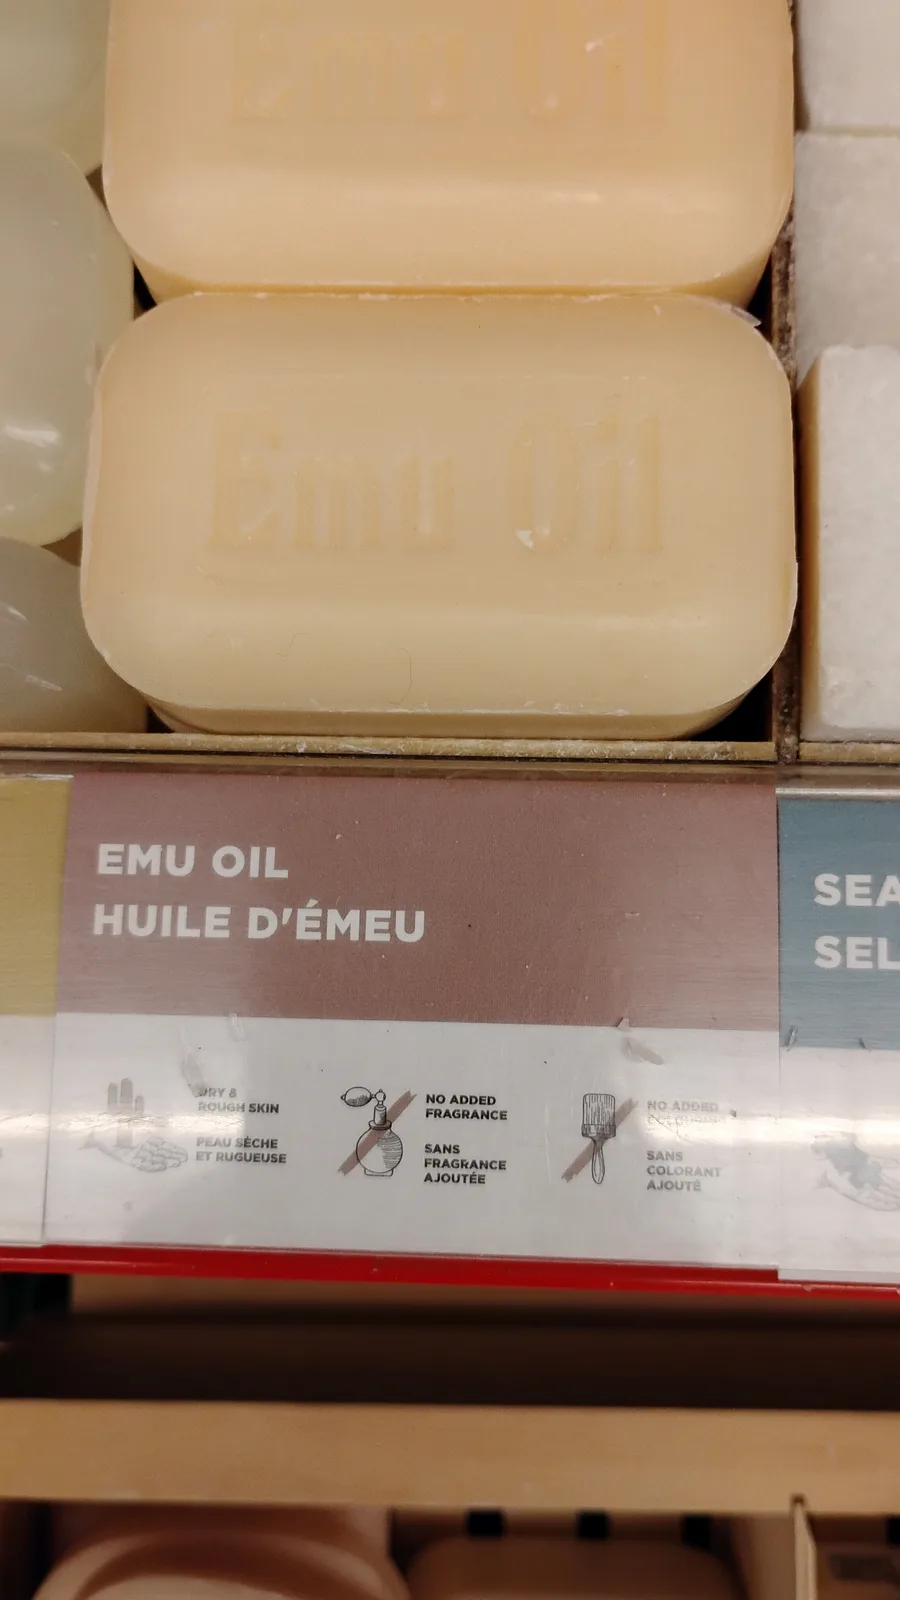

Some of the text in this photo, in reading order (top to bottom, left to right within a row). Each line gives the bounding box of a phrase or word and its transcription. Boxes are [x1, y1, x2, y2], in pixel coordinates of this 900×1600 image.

[207, 409, 666, 555] Emu Oil
[97, 843, 289, 879] EMU OIL
[813, 873, 900, 907] SEA
[93, 899, 425, 942] HUILE D'ÉMEU
[814, 935, 900, 970] SEL
[228, 1087, 238, 1098] &
[425, 1093, 497, 1106] NO ADDED
[646, 1100, 719, 1112] NO ADDED
[197, 1102, 280, 1114] ROUGH SKIN
[425, 1108, 508, 1121] FRAGRANCE
[196, 1134, 279, 1149] PEAU SÈCHE
[424, 1143, 461, 1154] SANS
[195, 1151, 288, 1164] ET RUGUEUSE
[646, 1150, 683, 1162] SANS
[424, 1158, 507, 1171] FRAGRANCE
[423, 1171, 487, 1184] AJOUTÉE
[646, 1165, 722, 1178] COLORANT
[646, 1179, 702, 1192] AJOUTÉ
